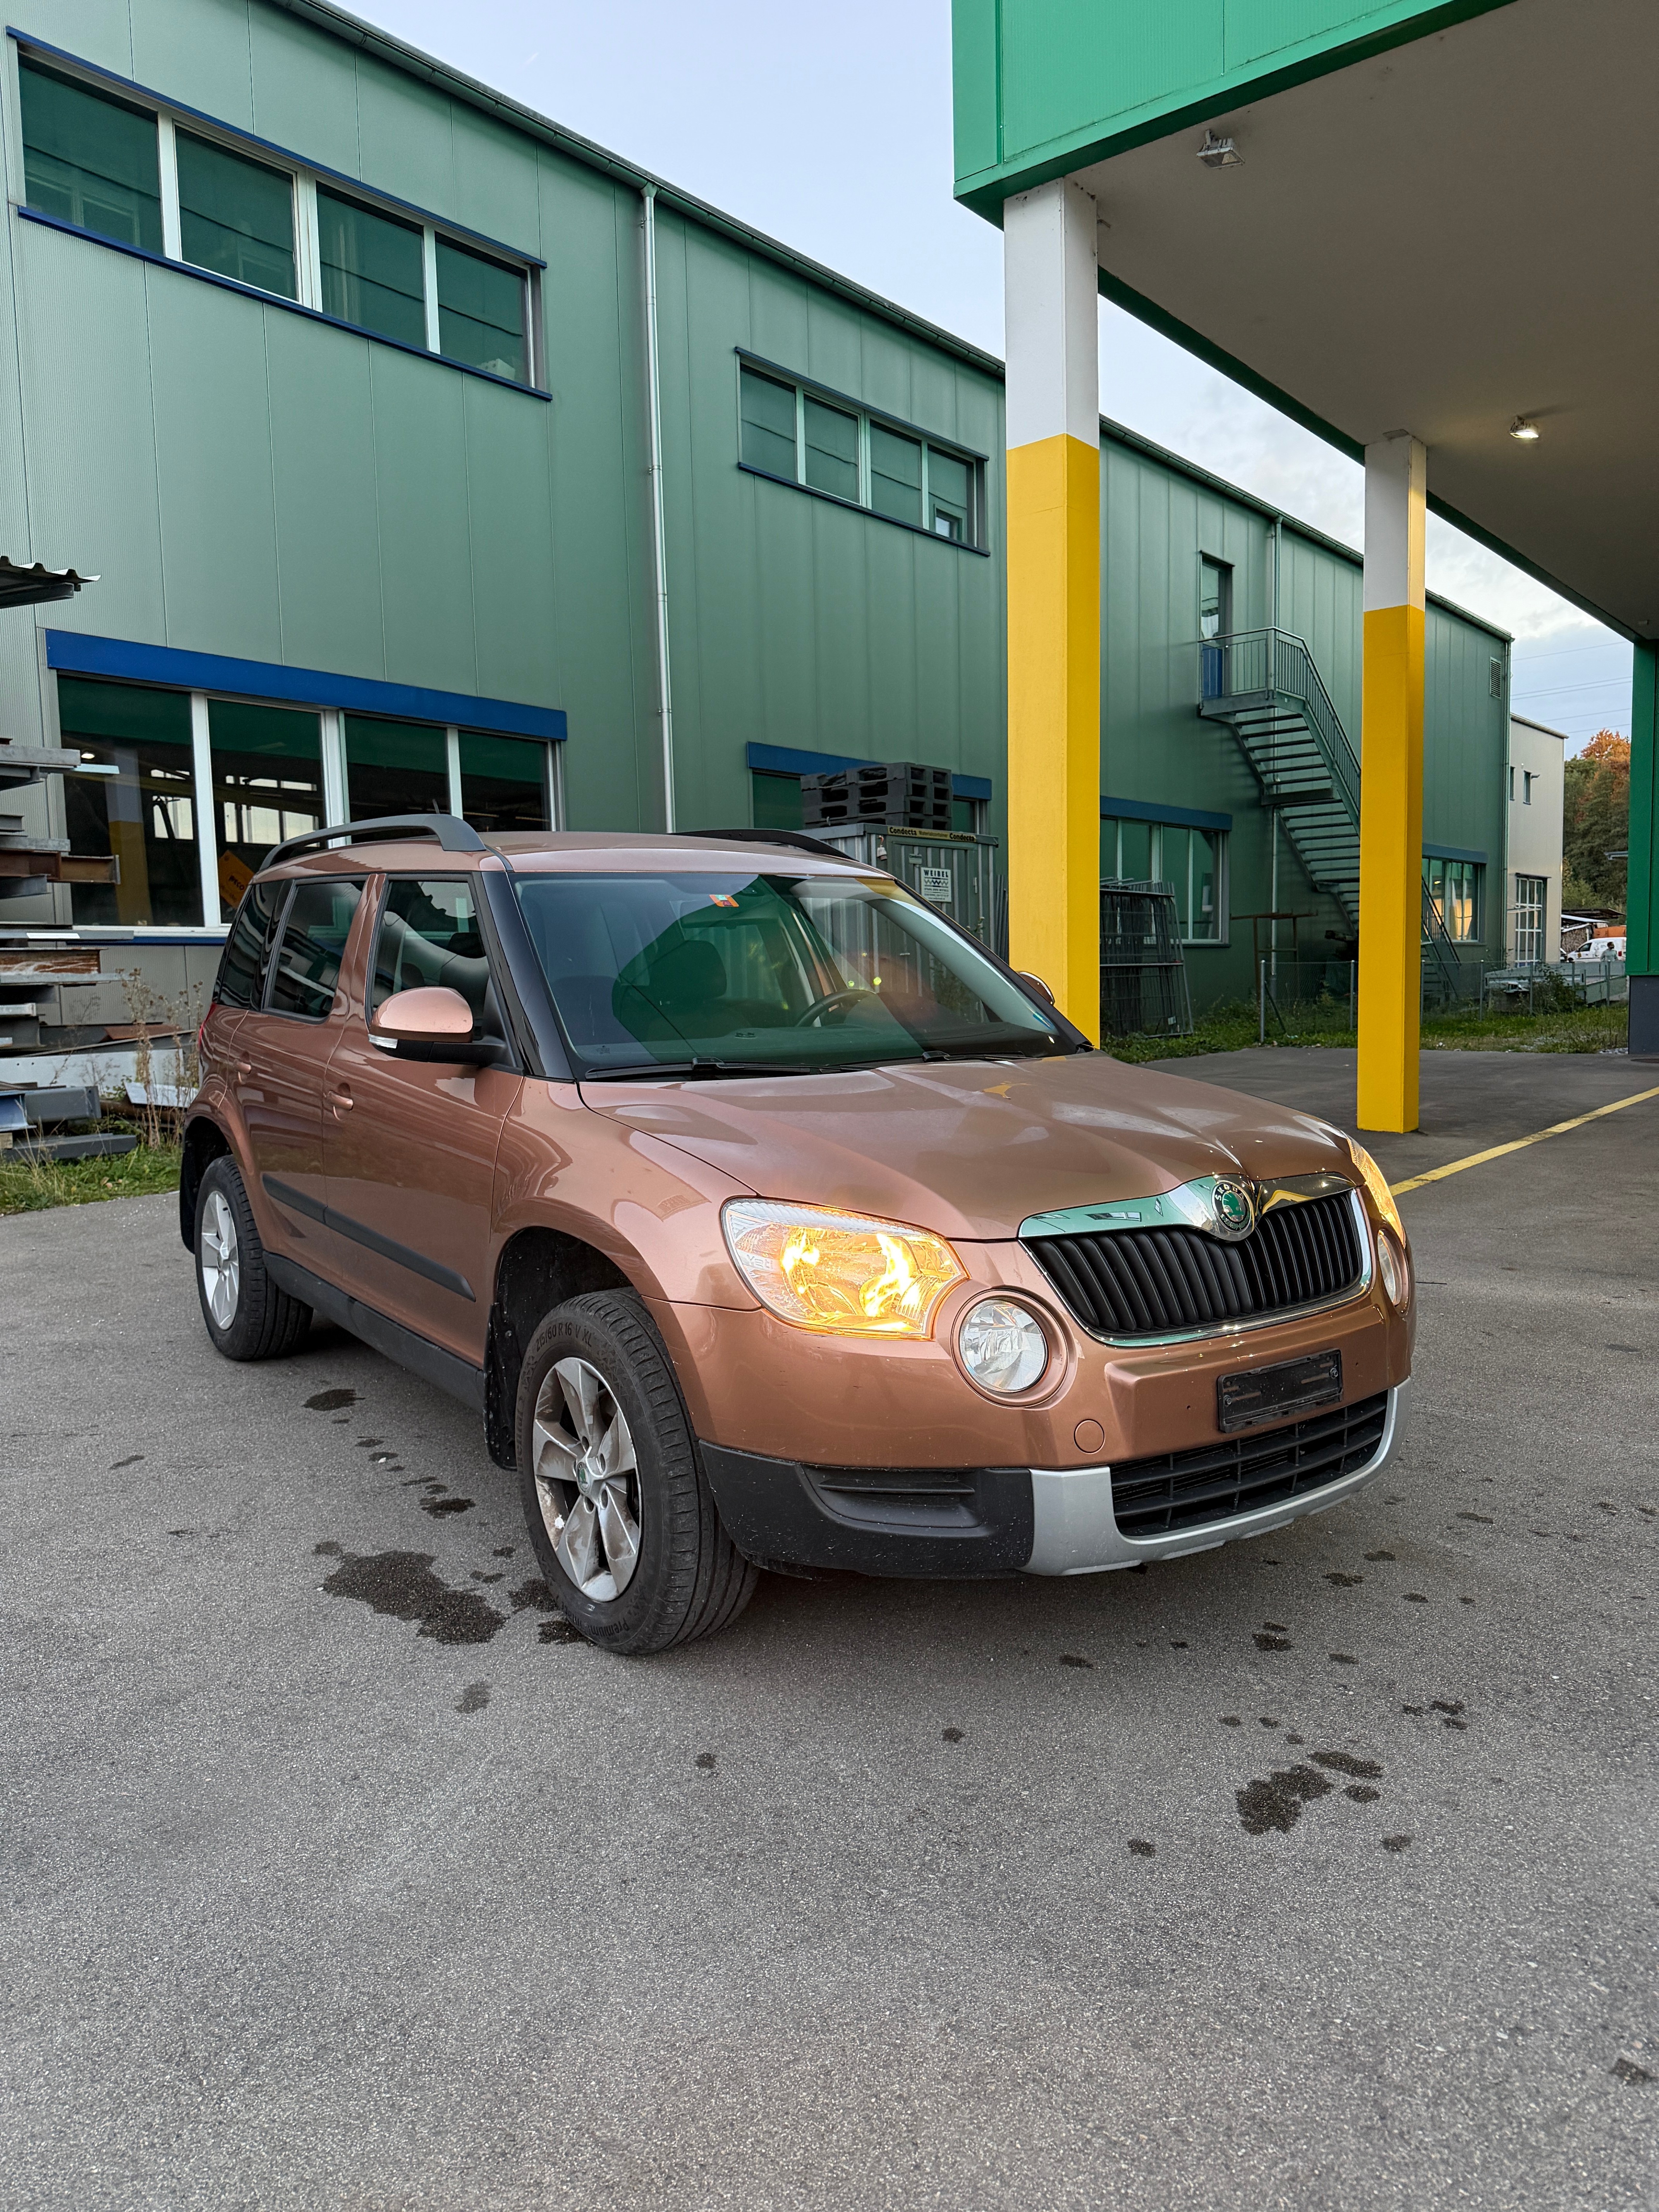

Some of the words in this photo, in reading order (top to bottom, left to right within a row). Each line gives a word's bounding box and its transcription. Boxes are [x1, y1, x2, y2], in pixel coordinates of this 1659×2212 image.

[890, 827, 917, 836] Condecta
[950, 833, 975, 841] Condecta
[536, 1324, 557, 1352] 215/60
[575, 1324, 581, 1338] V
[582, 1328, 592, 1348] XL
